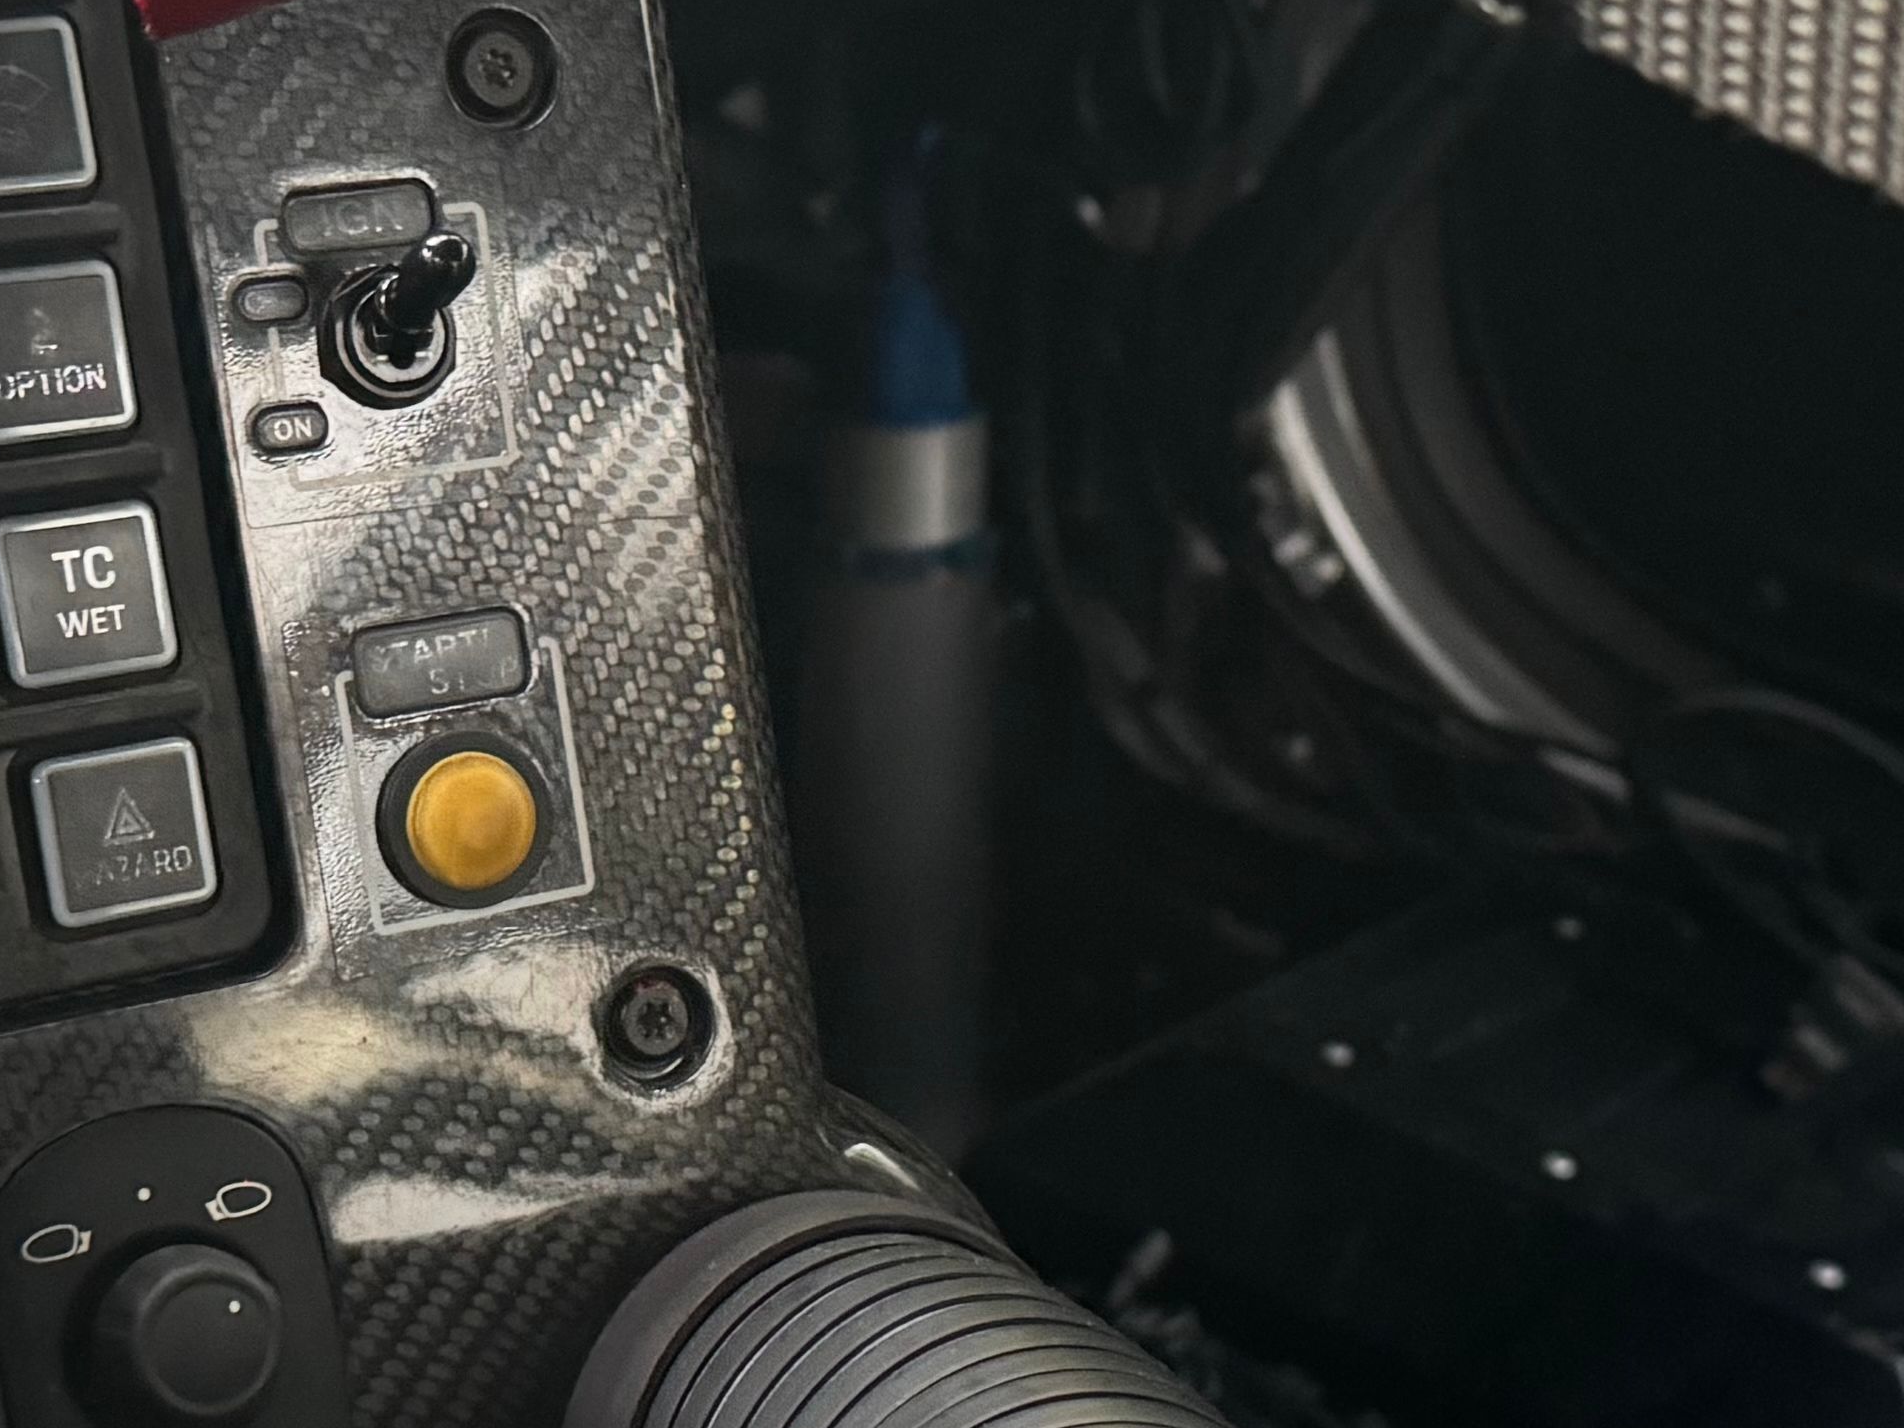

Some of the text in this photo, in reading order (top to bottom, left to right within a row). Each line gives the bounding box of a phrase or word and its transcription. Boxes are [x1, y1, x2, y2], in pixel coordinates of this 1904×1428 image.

[273, 417, 312, 442] ON
[51, 545, 116, 593] TC
[55, 604, 126, 639] WET
